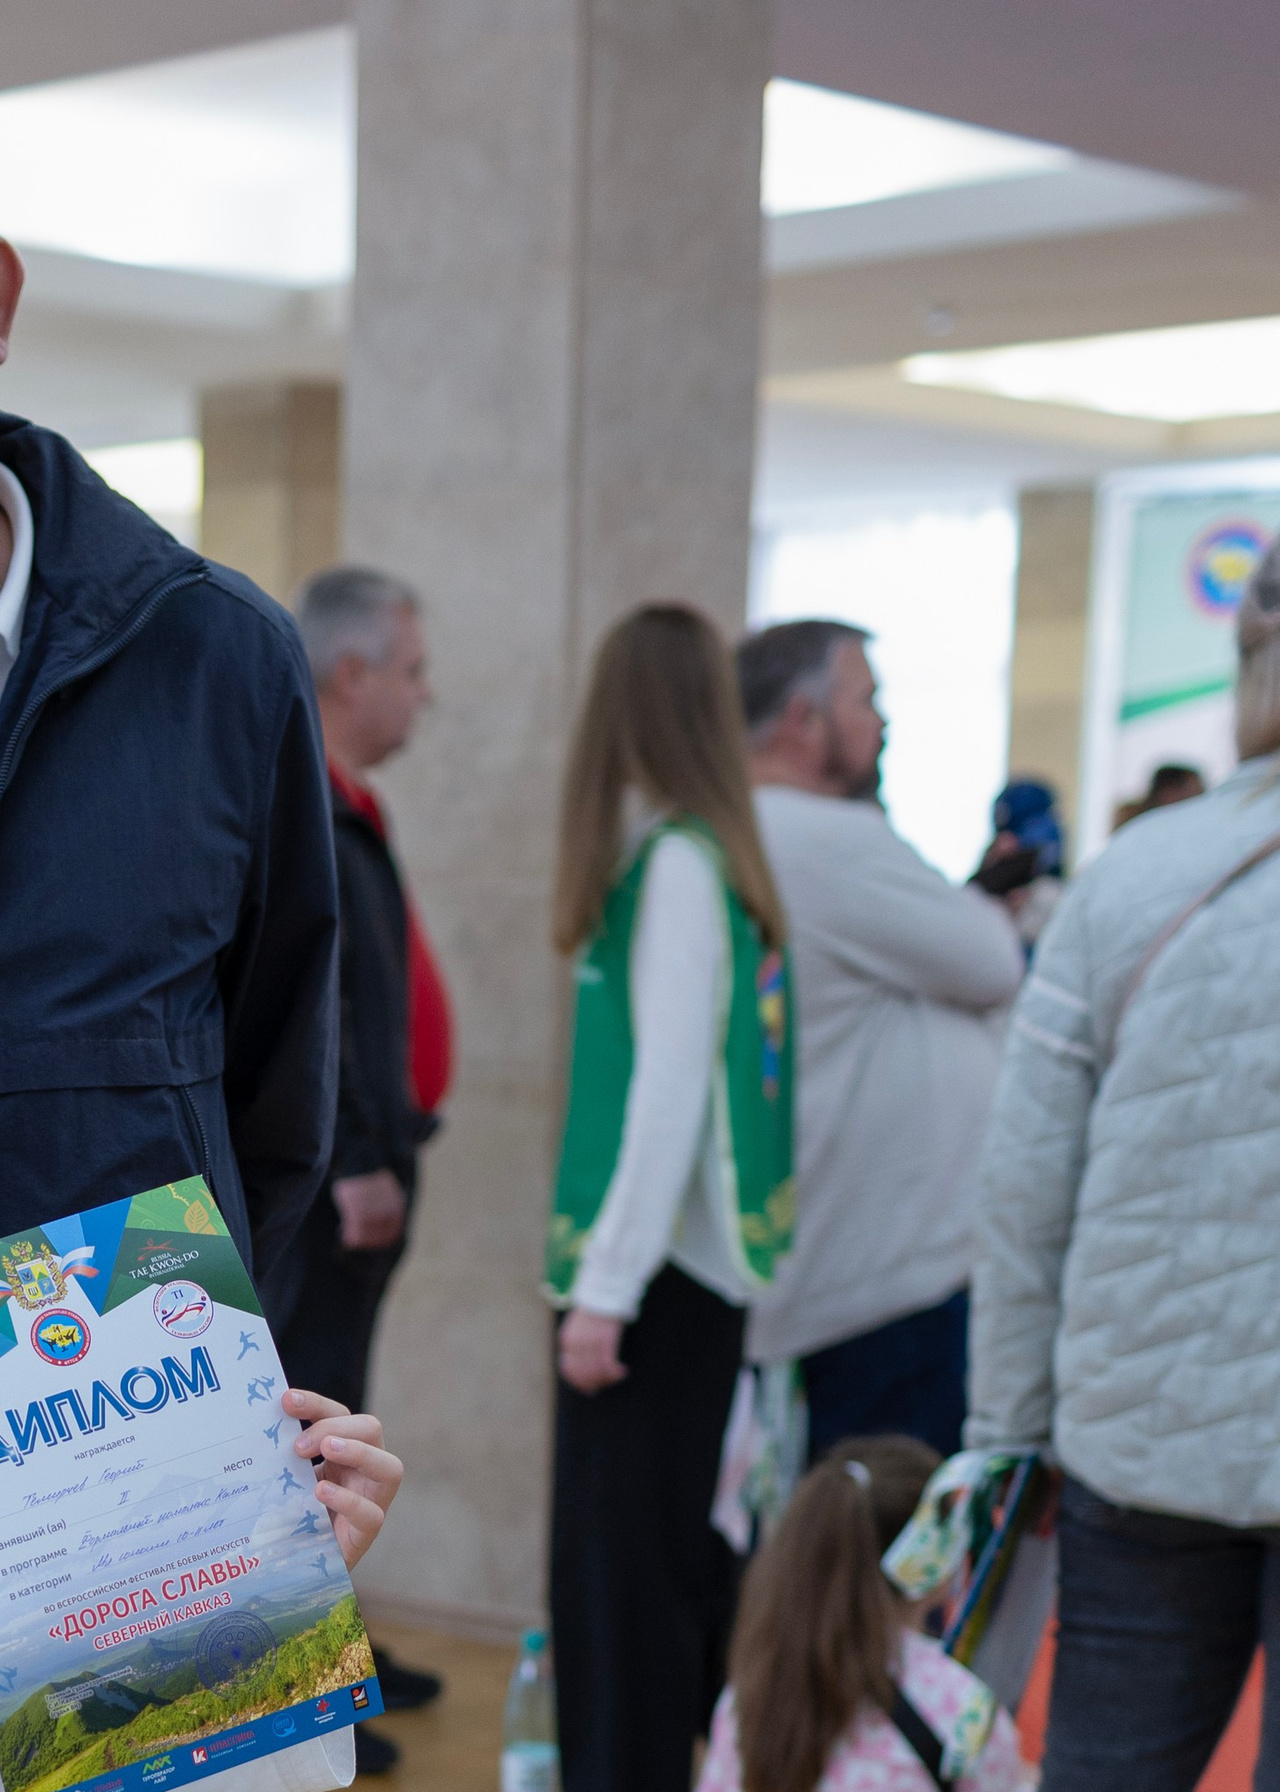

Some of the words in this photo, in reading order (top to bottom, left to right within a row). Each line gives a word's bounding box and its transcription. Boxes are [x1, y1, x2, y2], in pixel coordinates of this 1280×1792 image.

[150, 1251, 172, 1263] RUSSIA
[72, 1432, 137, 1462] награждается
[221, 1456, 254, 1474] место
[45, 1517, 68, 1535] (ая)
[7, 1546, 69, 1576] программе
[42, 1603, 57, 1613] ВО
[55, 1577, 127, 1609] ВСЕРОССИЙСКОМ
[126, 1561, 177, 1585] ФЕСТИВАЛЕ
[175, 1549, 210, 1567] БОЕВЫХ
[208, 1534, 250, 1556] ИСКУССТВ
[15, 1571, 73, 1600] категории
[48, 1588, 158, 1642] «ДОРОГА
[161, 1553, 260, 1599] СЛАВЫ»
[90, 1609, 172, 1652] СЕВЕРНЫЙ
[171, 1590, 233, 1623] КАВКАЗ
[141, 1765, 176, 1783] ТУРОПЕРАТОР
